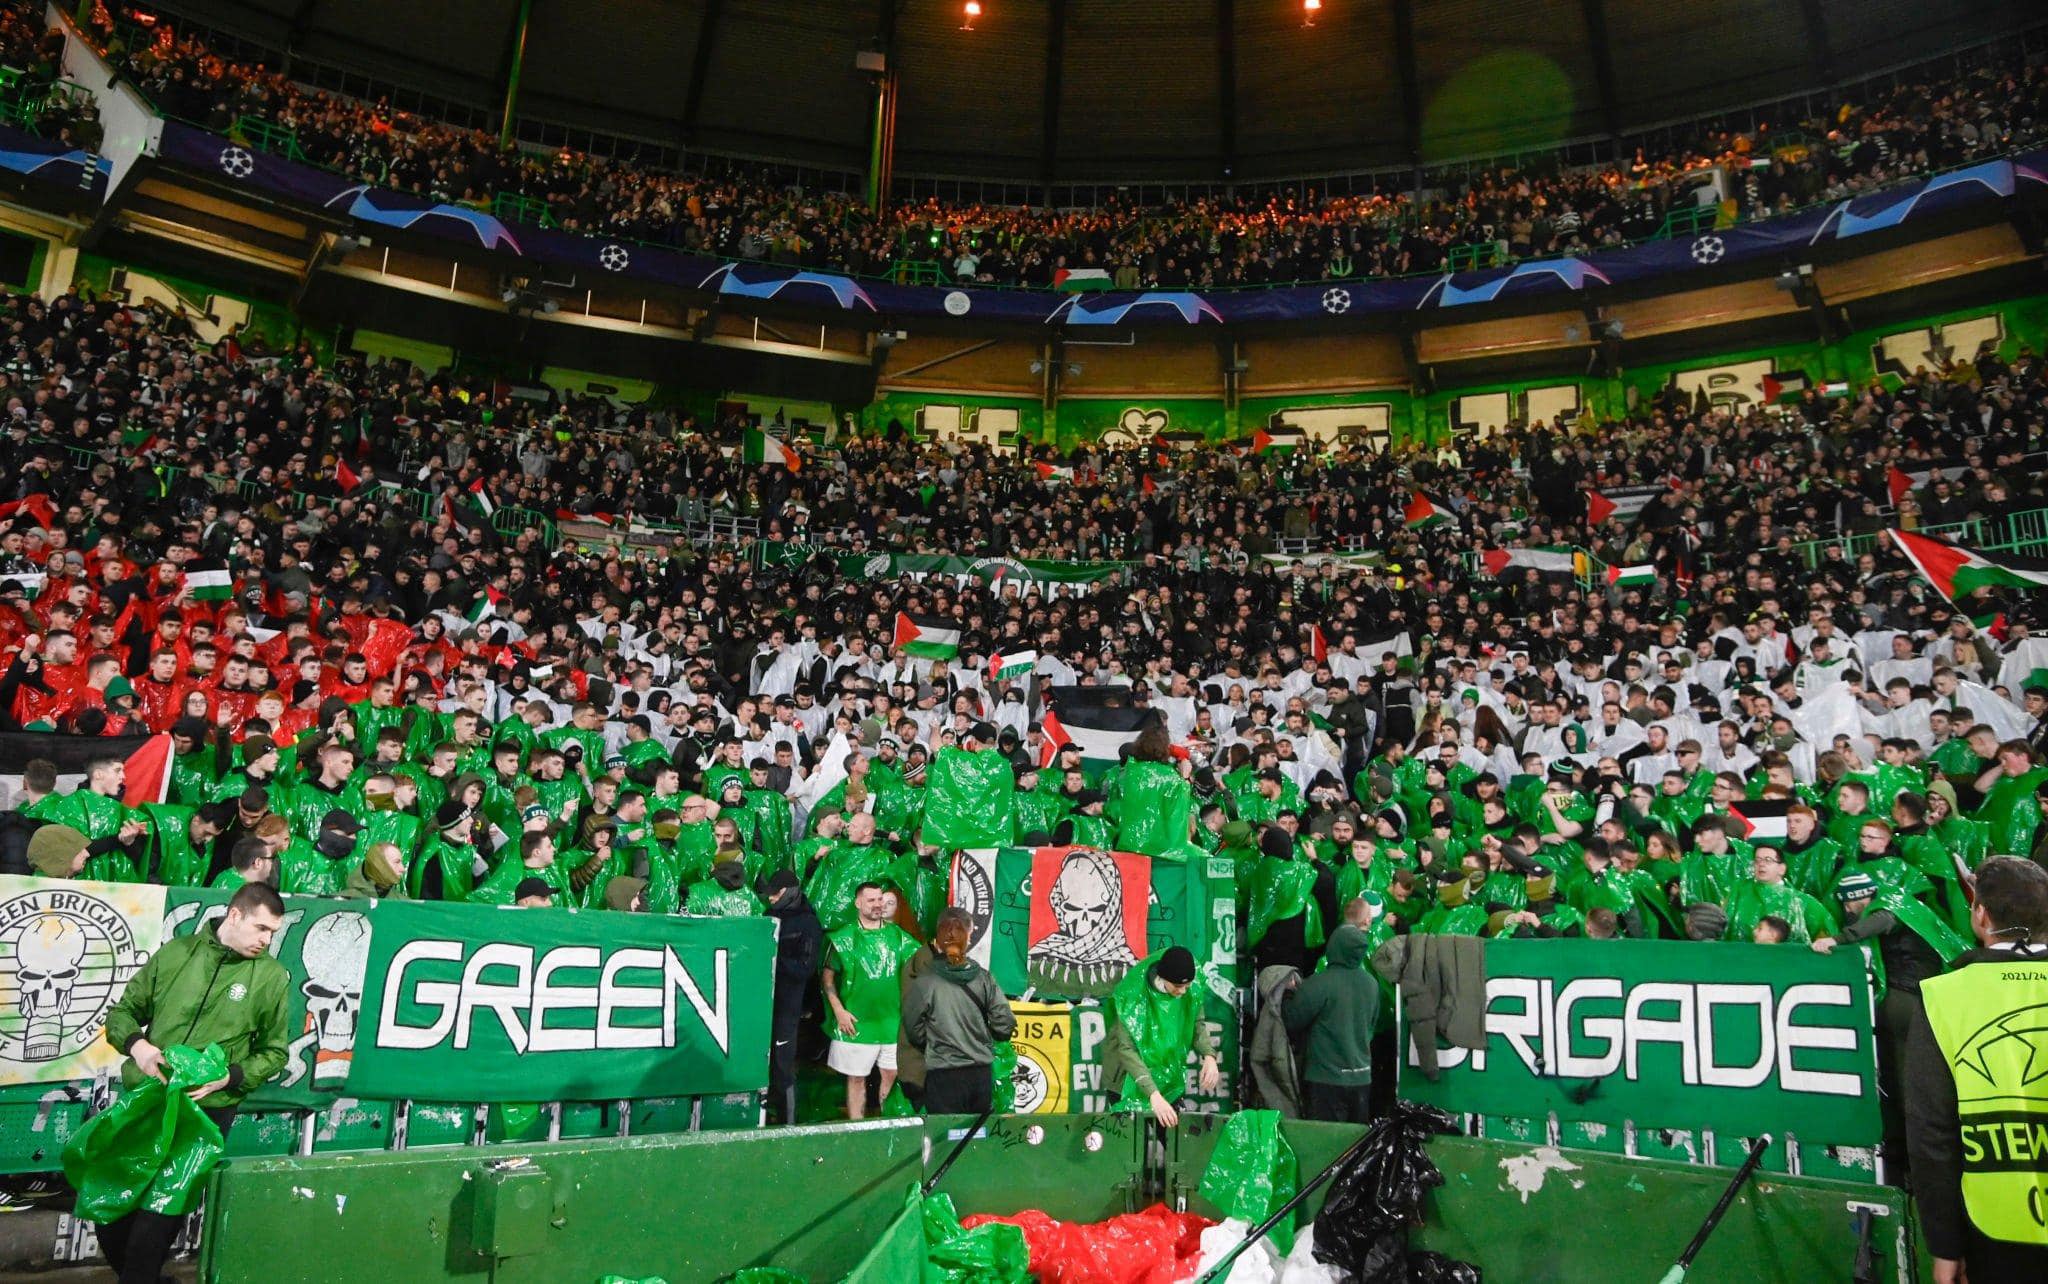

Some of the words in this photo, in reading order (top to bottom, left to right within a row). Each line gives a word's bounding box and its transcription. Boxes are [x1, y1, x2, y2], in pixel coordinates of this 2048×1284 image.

[973, 874, 988, 901] WITH
[977, 900, 989, 915] US
[50, 893, 131, 955] BRIGADE
[2001, 971, 2048, 981] 2021/24
[377, 938, 729, 1057] GREEN
[1025, 1022, 1043, 1039] IS
[1049, 1022, 1064, 1039] A
[1408, 976, 1862, 1097] RIGADE
